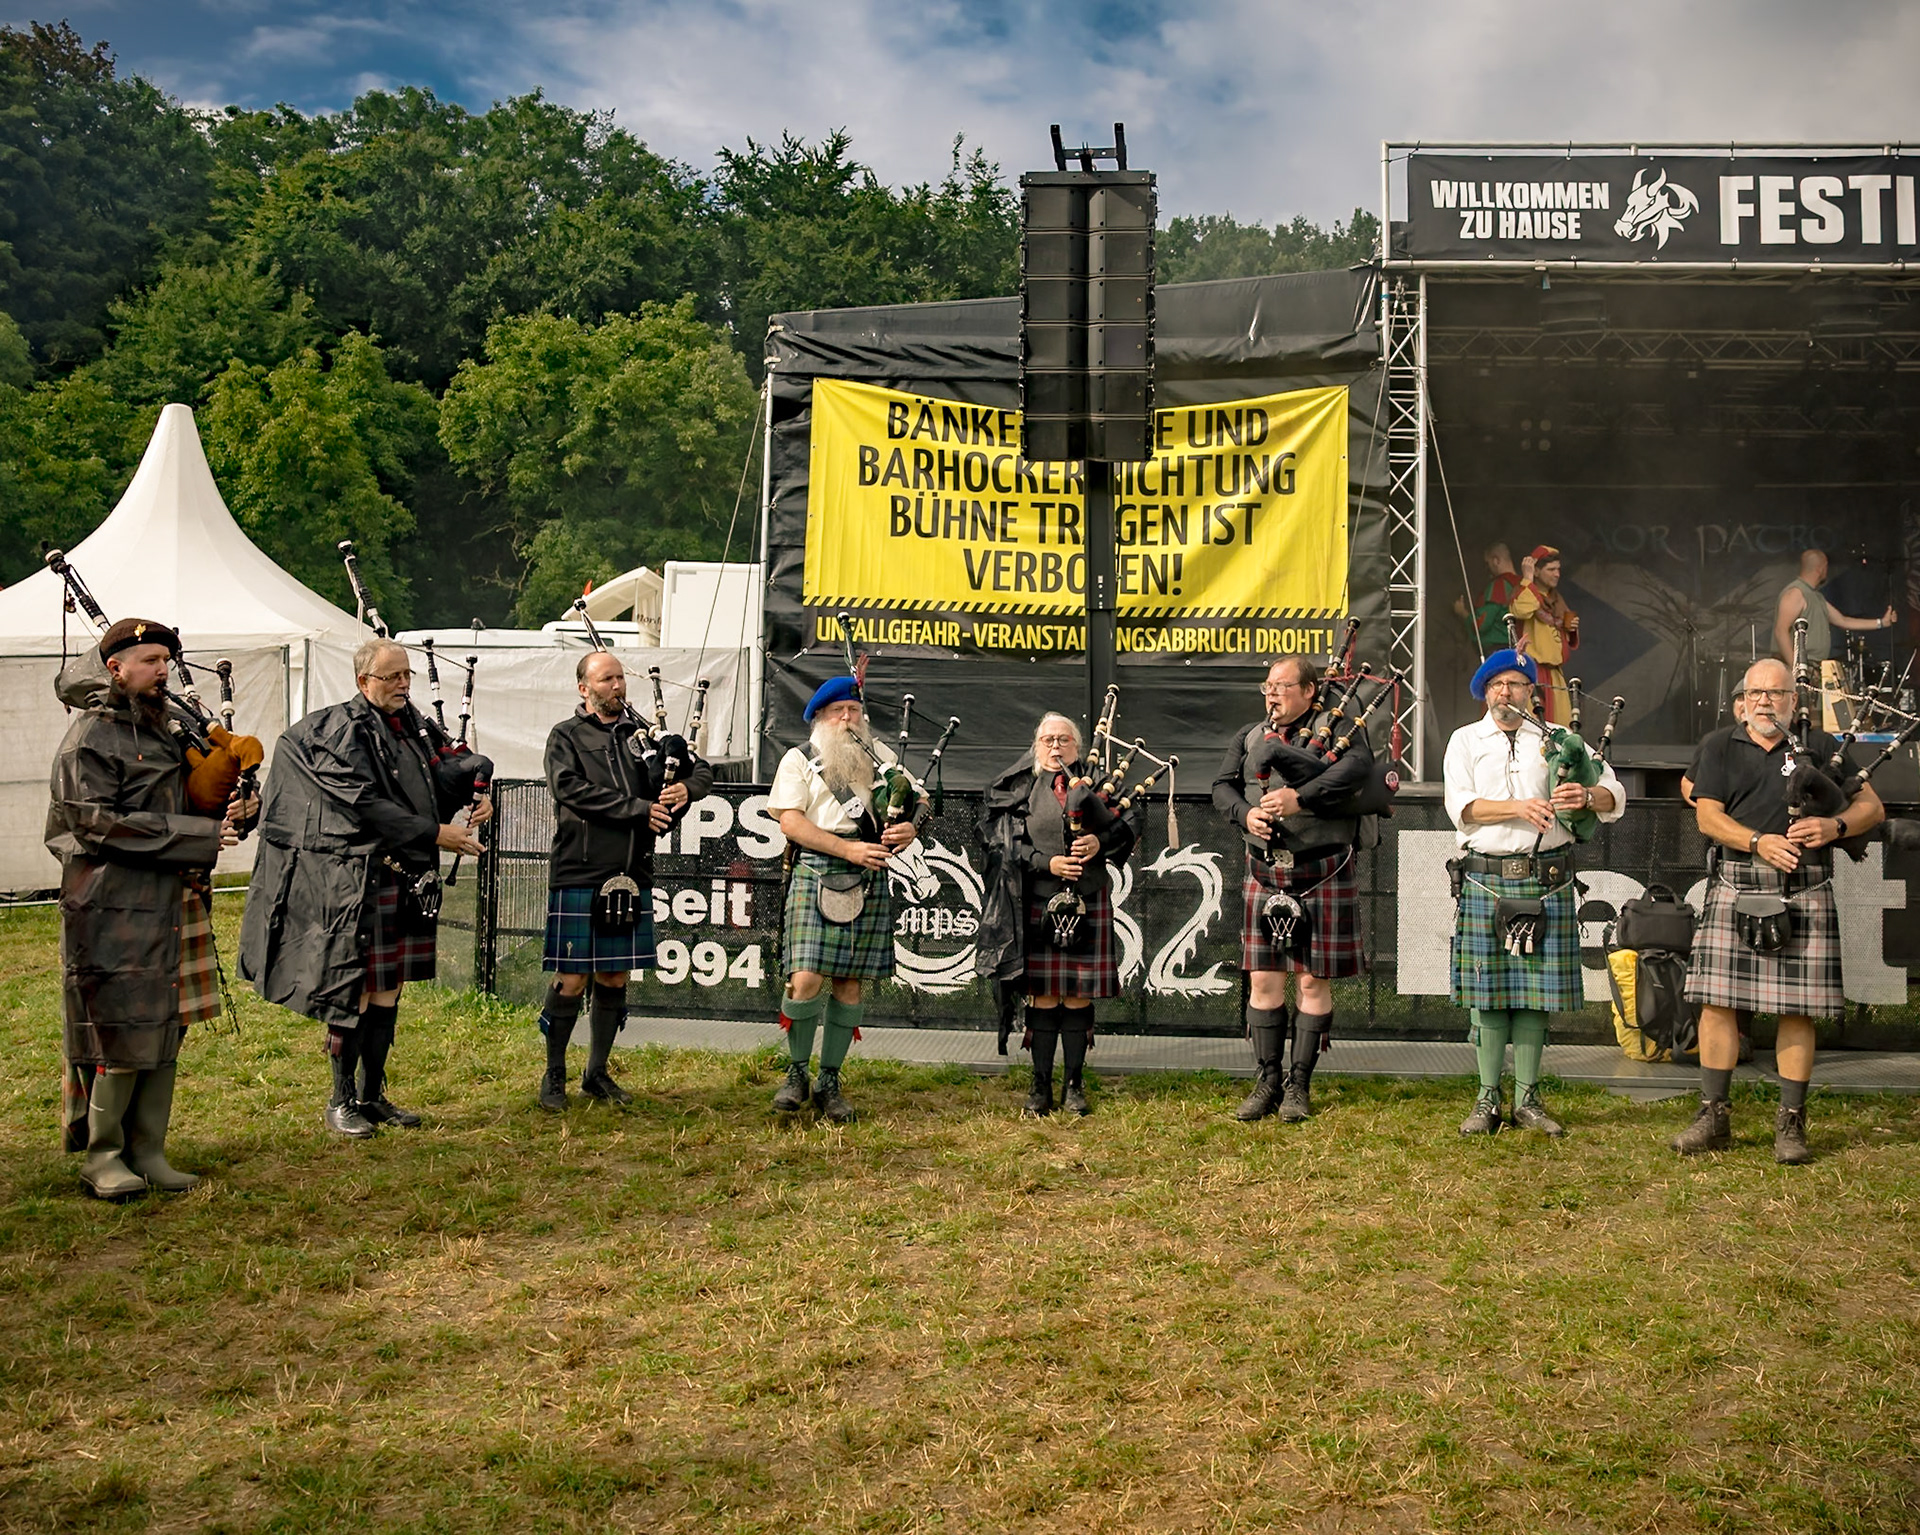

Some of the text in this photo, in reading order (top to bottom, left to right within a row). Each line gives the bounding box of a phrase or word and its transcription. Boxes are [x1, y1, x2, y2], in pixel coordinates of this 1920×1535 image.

[1431, 180, 1610, 210] WILLKOMMEN
[1718, 174, 1917, 246] FESTI
[1459, 211, 1582, 240] ZU HAUSE
[887, 397, 1018, 449] BÄNKE
[1187, 408, 1270, 449] UND
[858, 445, 1085, 496] BARHOCKER
[889, 490, 1262, 546] BÜHNE TRGEN IST
[963, 547, 1184, 597] VERBOEN!
[653, 794, 788, 860] PS
[652, 878, 753, 928] seit
[630, 938, 765, 989] 994
